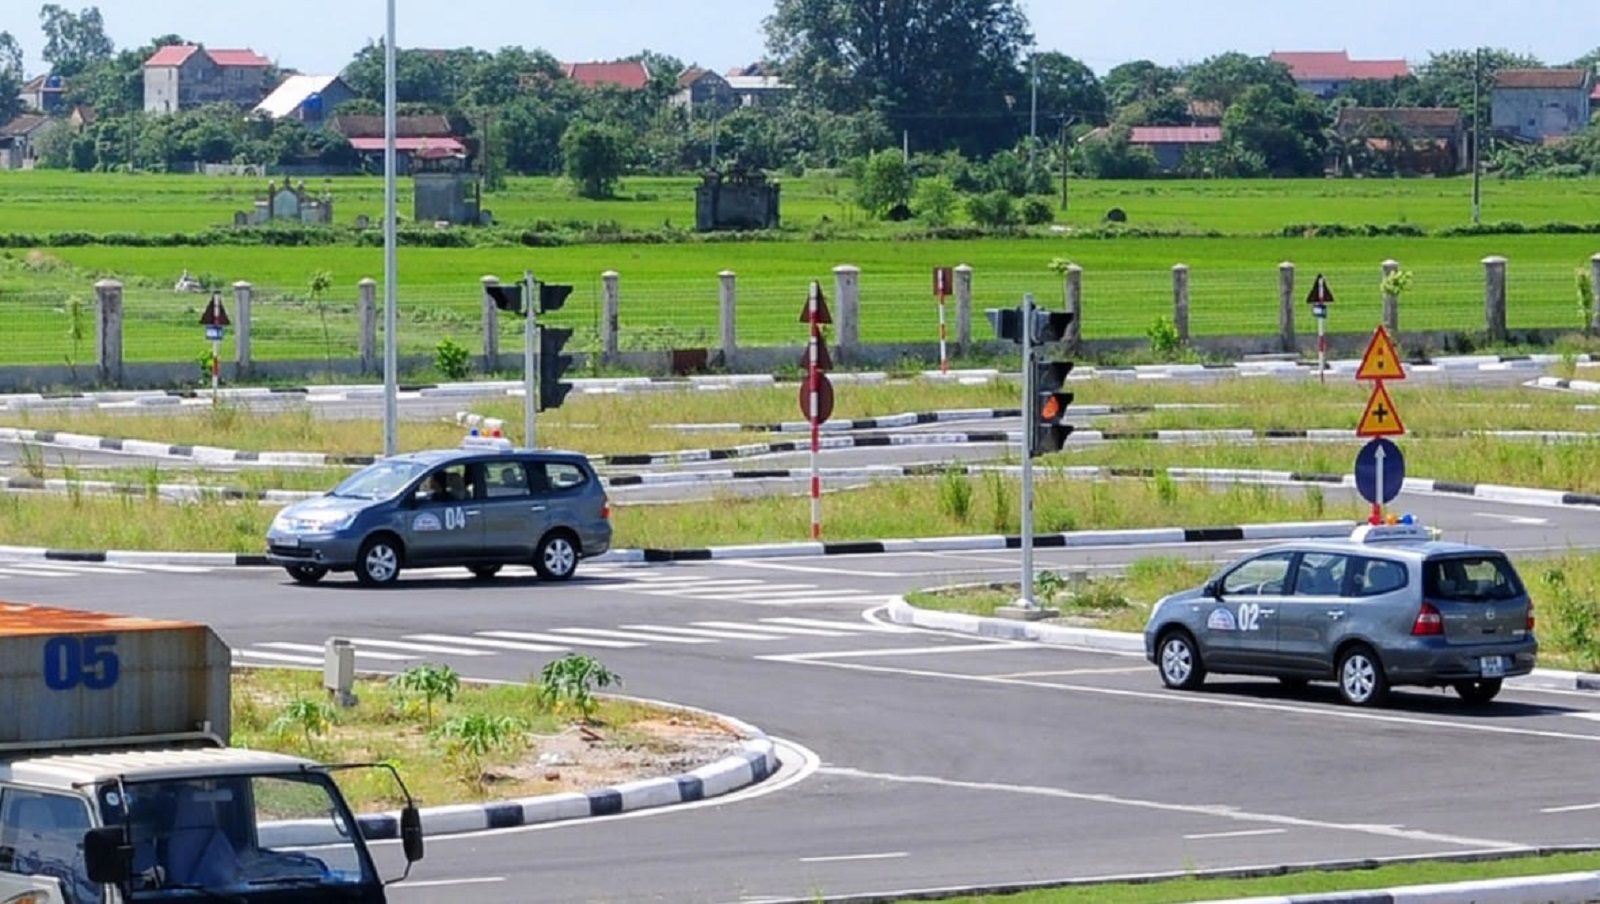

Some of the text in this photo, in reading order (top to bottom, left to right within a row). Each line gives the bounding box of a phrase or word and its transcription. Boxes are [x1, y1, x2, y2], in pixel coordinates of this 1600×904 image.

[445, 506, 466, 530] 04
[1237, 603, 1259, 631] 02
[43, 635, 120, 691] 05
